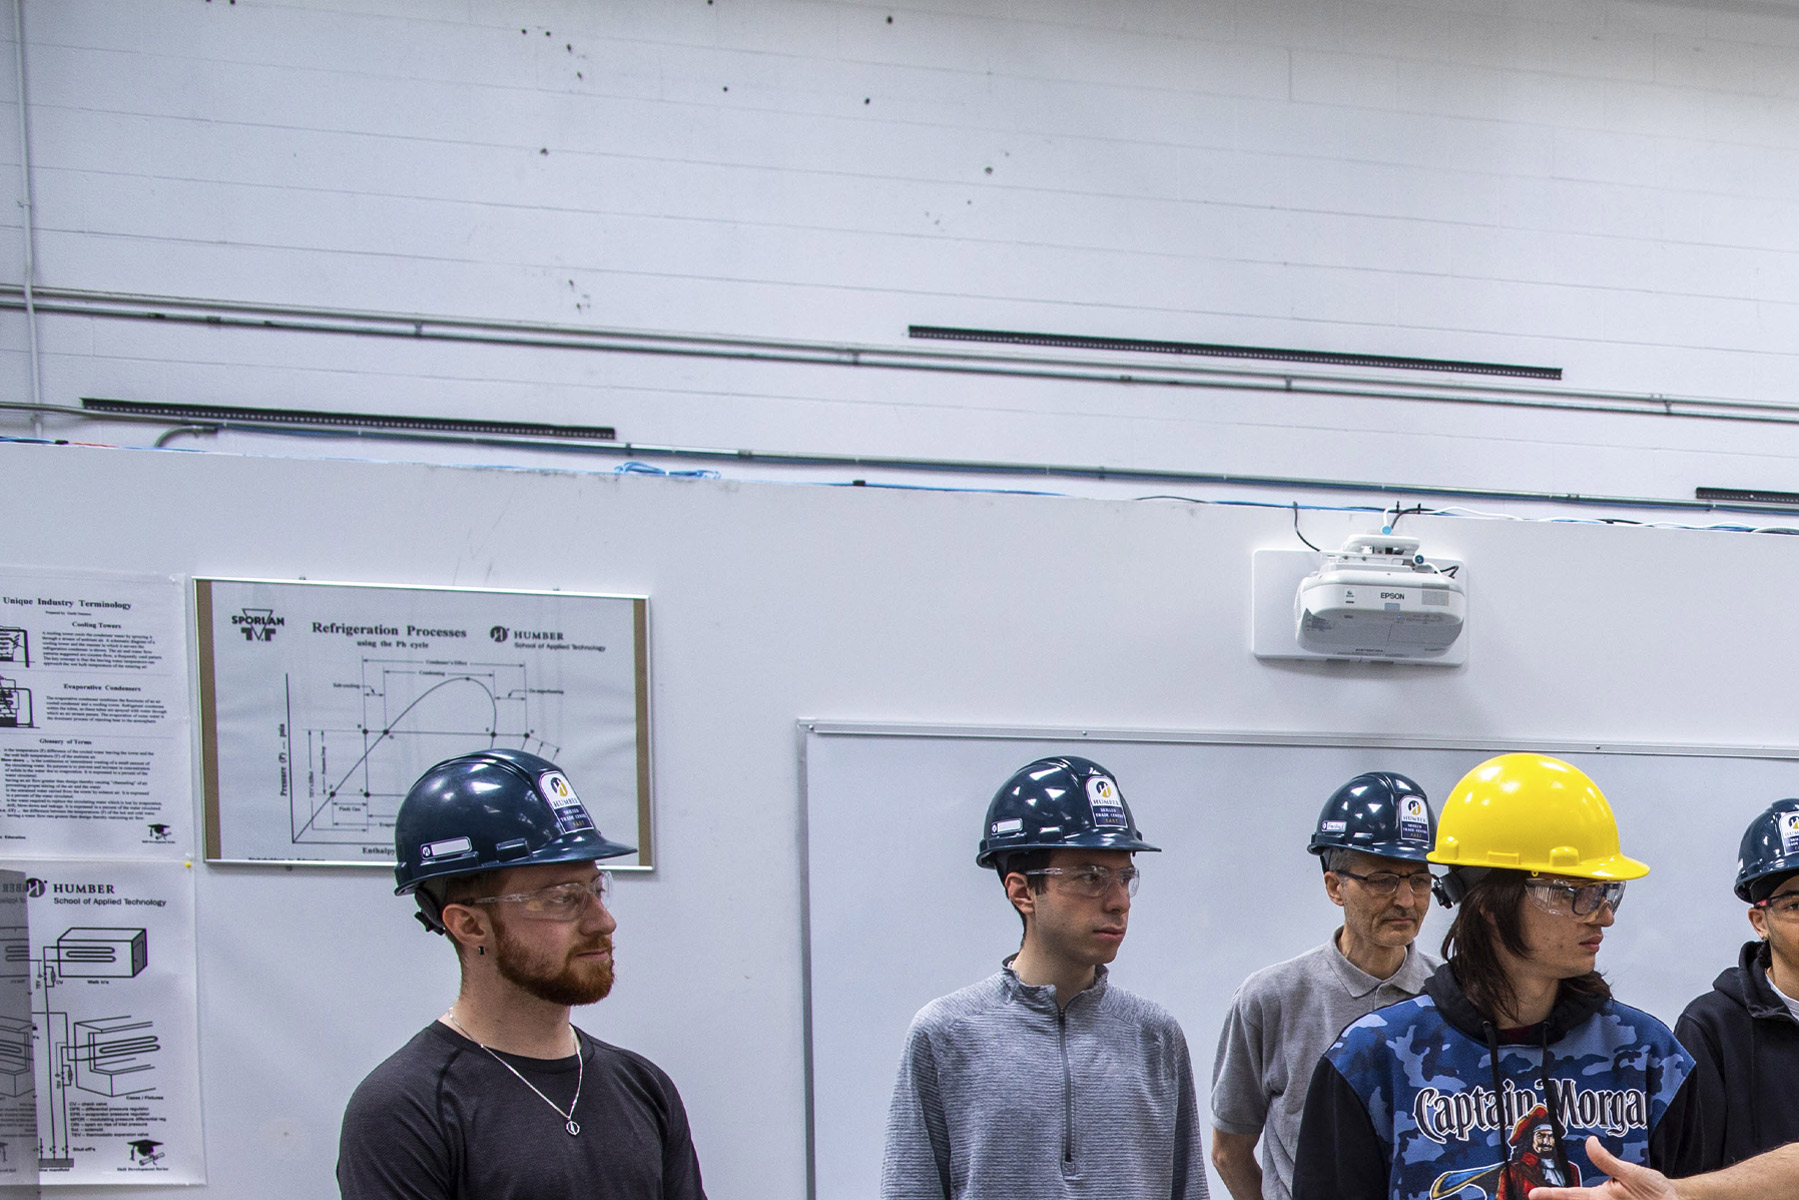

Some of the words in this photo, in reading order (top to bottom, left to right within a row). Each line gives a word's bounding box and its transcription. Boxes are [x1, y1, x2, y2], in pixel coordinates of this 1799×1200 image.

[1380, 592, 1405, 600] EPSON
[3, 597, 33, 606] Unique
[38, 598, 74, 608] Industry
[79, 599, 132, 610] Terminology
[232, 615, 285, 626] SPORLAN
[72, 621, 97, 630] Cooling
[312, 622, 399, 637] Refrigeration
[407, 625, 467, 638] Processes
[514, 631, 564, 640] HUMBER
[410, 641, 429, 649] cycle
[63, 684, 102, 692] Evaporative
[39, 738, 64, 746] Glossary
[280, 766, 288, 797] Pressure
[362, 847, 395, 856] Enthalpy
[54, 883, 116, 894] HUMBER
[54, 897, 81, 905] School
[84, 897, 91, 905] of
[93, 897, 122, 906] Applied
[124, 898, 167, 907] Technology
[1413, 1079, 1539, 1144] Captain
[1534, 1078, 1648, 1136] Morga
